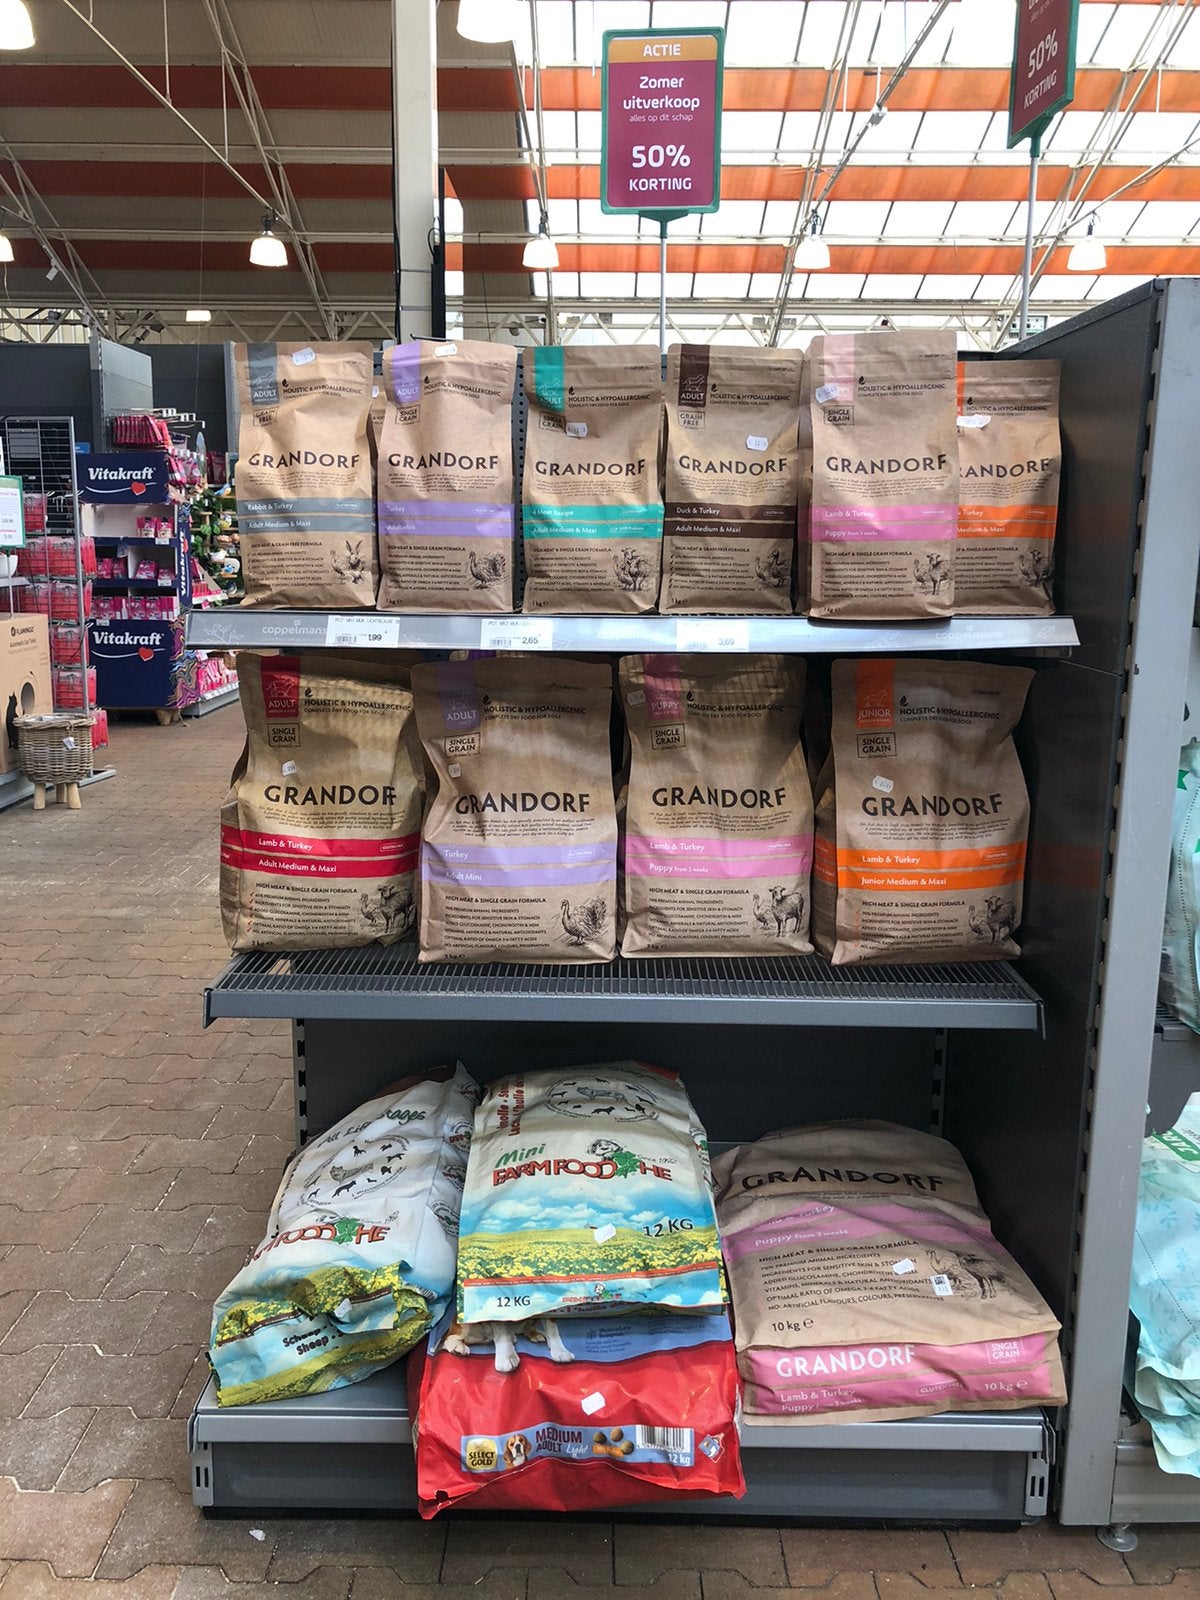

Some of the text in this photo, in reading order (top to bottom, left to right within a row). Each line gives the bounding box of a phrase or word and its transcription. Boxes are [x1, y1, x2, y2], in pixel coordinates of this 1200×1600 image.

[643, 44, 681, 56] ACTIE
[1028, 29, 1058, 79] 50%
[639, 76, 684, 89] Zomer
[1024, 69, 1057, 109] KORTING
[623, 95, 700, 111] uitverkoop
[629, 114, 646, 122] alles
[672, 113, 693, 121] schap
[632, 145, 690, 168] 50%
[629, 178, 692, 191] KORTING
[254, 390, 276, 398] ADULT
[397, 387, 420, 395] ADULT
[249, 451, 360, 468] GRANDORF
[388, 452, 498, 470] GRANDORF
[679, 455, 787, 476] GRANDORF
[826, 454, 947, 474] GRANDORF
[88, 467, 154, 480] Vitakraft
[536, 459, 645, 476] GRANDORF
[959, 458, 1049, 478] ANDORF
[699, 508, 720, 516] Turkey
[853, 511, 874, 519] Turkey
[963, 509, 984, 518] Turkey
[92, 631, 162, 645] Vitakraft
[262, 625, 327, 640] coppelmans
[718, 638, 734, 646] 3,69
[268, 700, 295, 708] ADULT
[347, 701, 412, 712] HYPOALLERGENIC
[651, 702, 679, 710] PUPPY
[447, 711, 477, 721] ADULT
[525, 706, 586, 715] HYPOALLERGENIC
[858, 708, 891, 720] JUNIOR
[272, 727, 296, 735] SINGLE
[655, 729, 679, 737] SINGLE
[449, 737, 475, 745] SINGLE
[656, 737, 680, 745] GRAIN
[862, 737, 890, 745] SINGLE
[449, 745, 475, 753] GRAIN
[862, 745, 890, 753] GRAIN
[264, 785, 397, 806] GRANDORF
[652, 785, 786, 808] GRANDORF
[455, 792, 590, 814] GRANDORF
[862, 793, 1003, 817] GRANDORF
[288, 841, 313, 851] Turkey
[650, 842, 670, 850] Lamb
[680, 843, 705, 852] Turkey
[444, 849, 468, 860] Turkey
[894, 856, 920, 865] Turkey
[258, 860, 277, 868] Adult
[278, 862, 309, 871] Medium
[319, 864, 336, 872] Maxi
[649, 864, 673, 873] Puppy
[446, 872, 482, 881] Adult Mini
[861, 877, 885, 885] Junior
[384, 1109, 426, 1125] tages
[496, 1144, 546, 1168] Mini
[493, 1158, 672, 1186] FARMFOOD HE
[742, 1166, 943, 1192] GRANDORF
[643, 1218, 693, 1238] 12 KG
[355, 1225, 390, 1245] HE
[755, 1234, 791, 1246] Puppy
[823, 1229, 848, 1237] weeks
[782, 1251, 805, 1259] MEAT
[876, 1240, 919, 1250] FORMULA
[497, 1296, 531, 1307] 12 KG
[771, 1319, 801, 1332] 10 kg
[297, 1336, 329, 1355] Sheep
[992, 1342, 1018, 1351] SINGLE
[992, 1350, 1020, 1359] GRAIN
[776, 1344, 915, 1378] GRANDORF
[999, 1382, 1013, 1391] kg
[781, 1389, 855, 1402] Lamb & Turkey
[782, 1404, 814, 1413] Puppy
[536, 1428, 582, 1445] MEDIUM
[469, 1451, 496, 1460] SELECT
[536, 1443, 588, 1458] ADULT Light
[471, 1457, 492, 1466] GOLD
[668, 1454, 690, 1466] 12 kg
